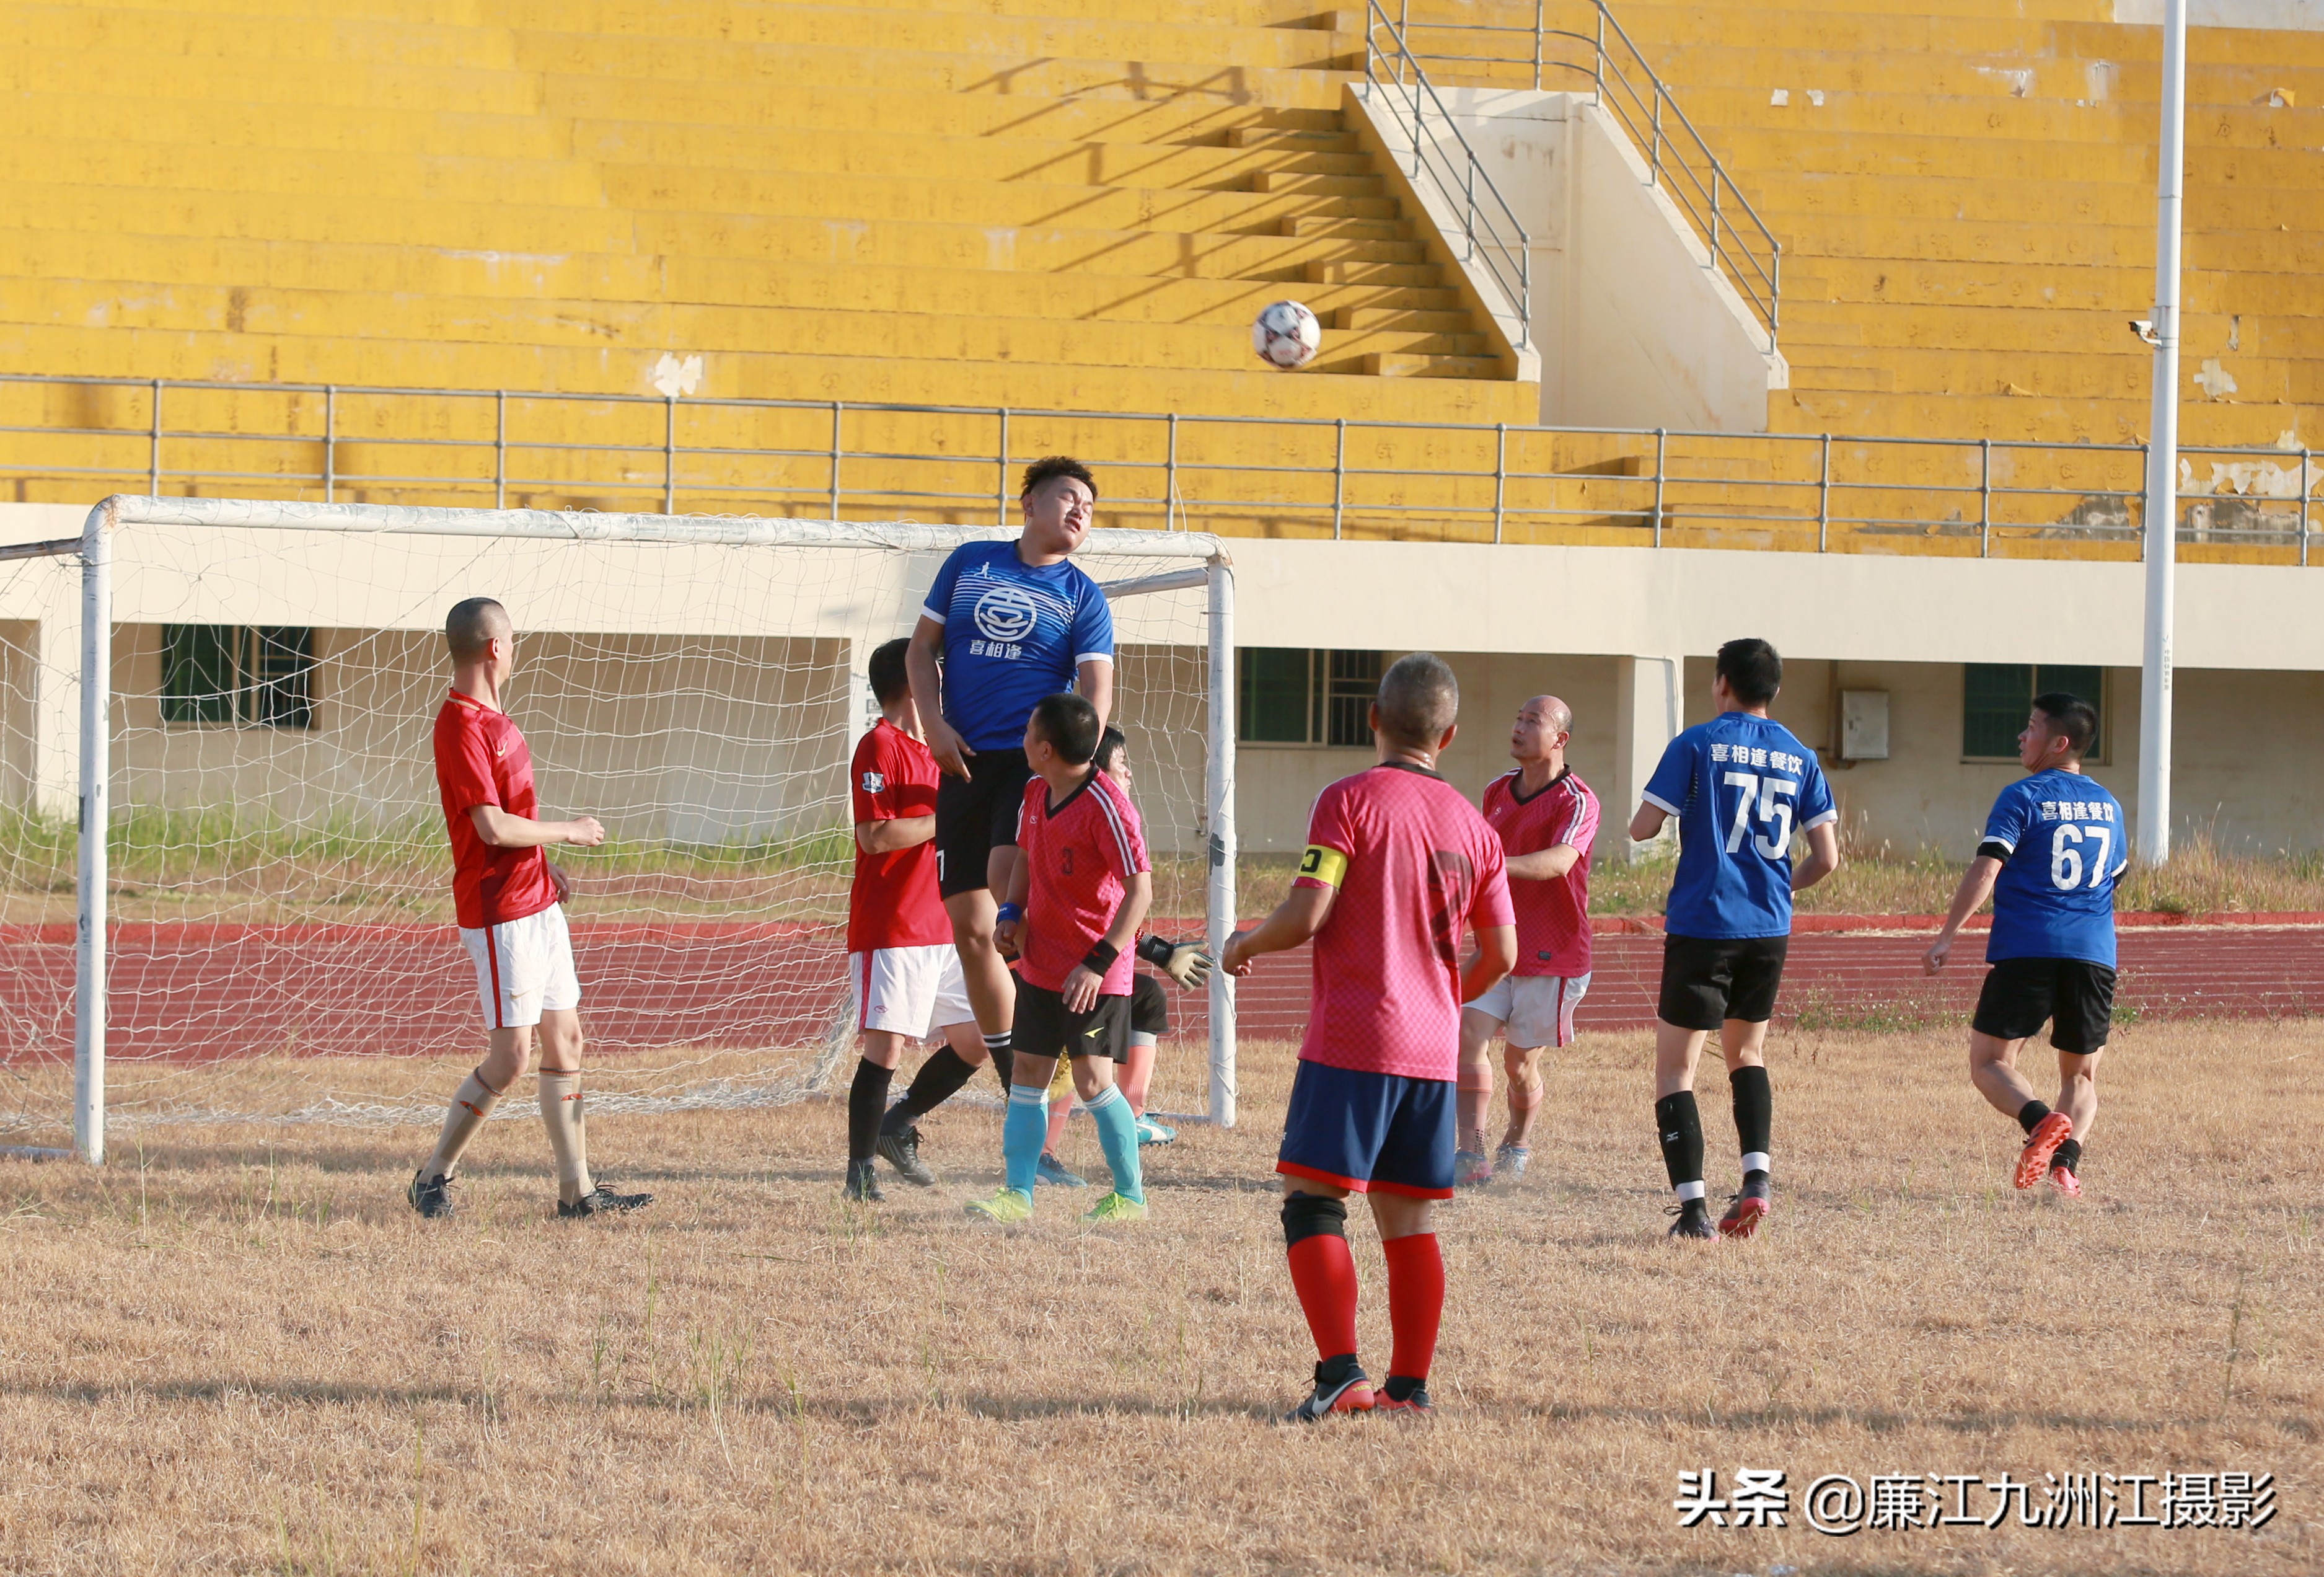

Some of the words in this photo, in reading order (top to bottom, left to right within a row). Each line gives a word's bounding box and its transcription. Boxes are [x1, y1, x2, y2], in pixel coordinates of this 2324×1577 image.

[969, 639, 1022, 660] 喜相逢
[1710, 743, 1803, 775] 喜相逢餐饮
[1723, 771, 1797, 860] 75
[2041, 800, 2115, 823] 喜相逢餐饮
[1062, 846, 1074, 876] 3
[2051, 823, 2110, 891] 67
